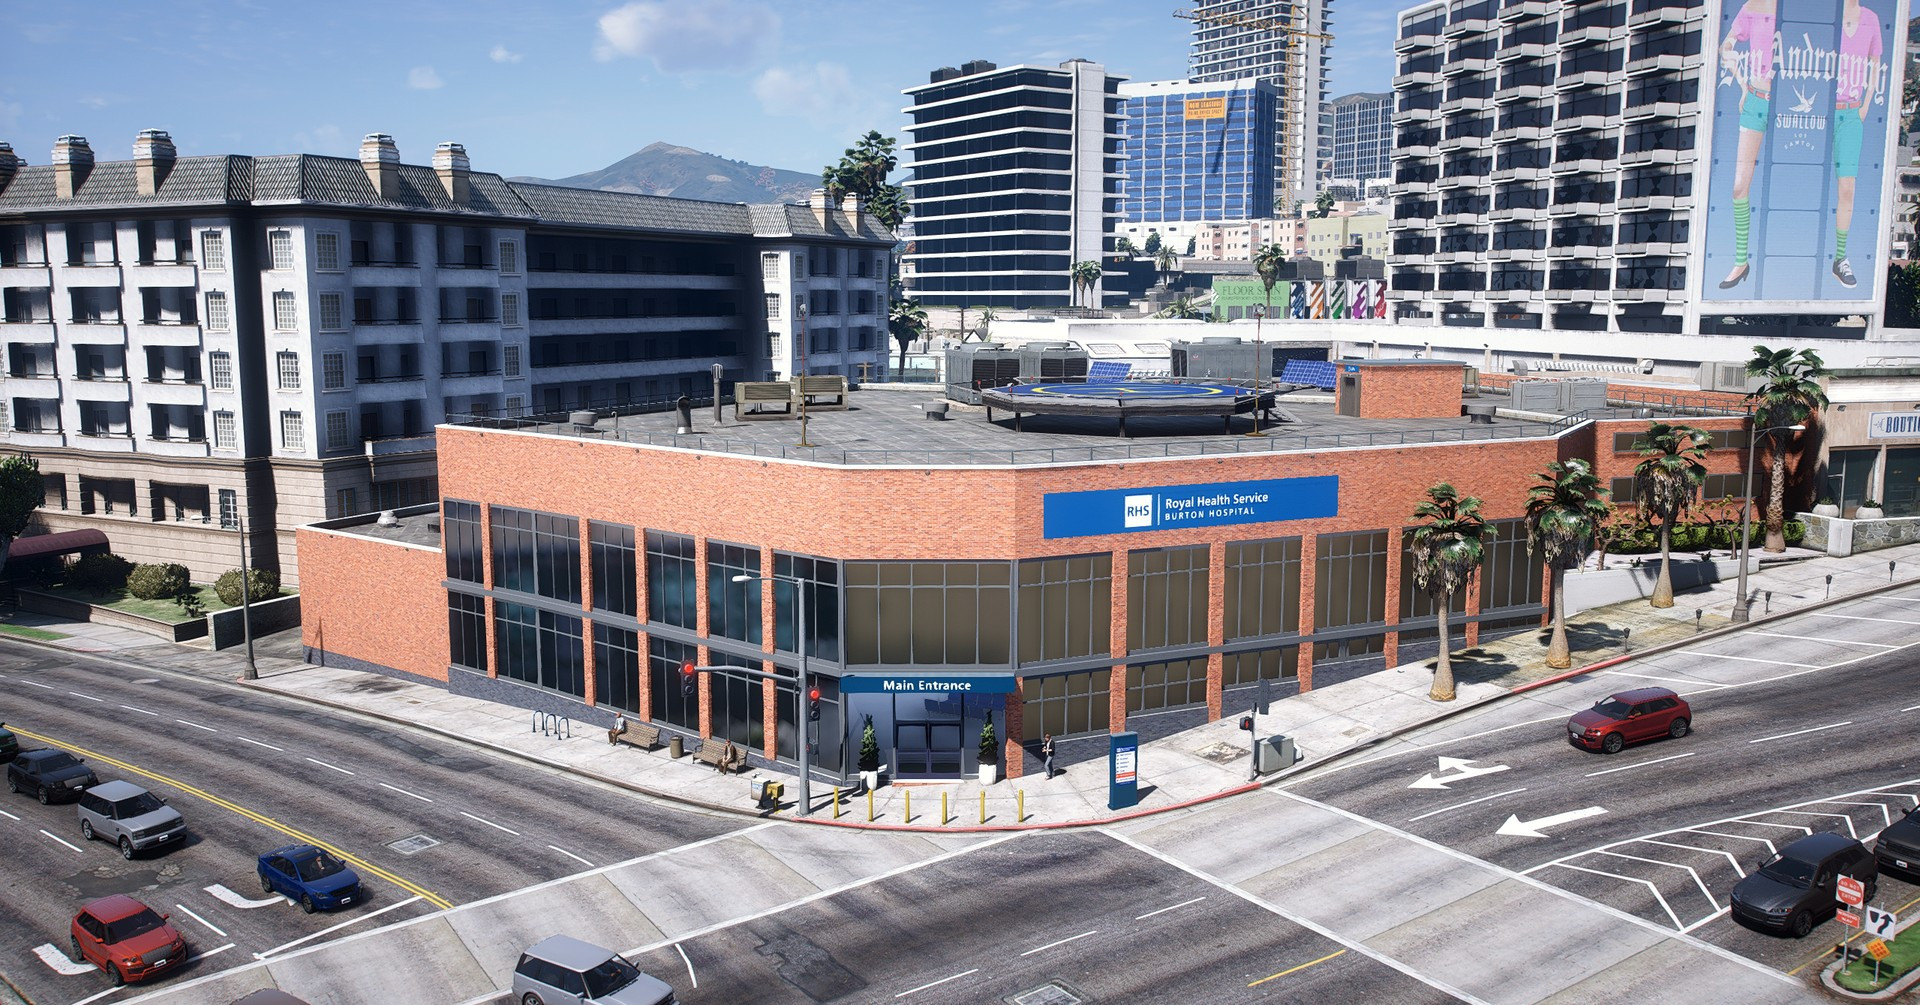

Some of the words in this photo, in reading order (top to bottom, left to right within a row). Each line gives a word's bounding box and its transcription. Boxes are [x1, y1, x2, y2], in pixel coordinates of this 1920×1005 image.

[1718, 46, 1764, 90] San
[1765, 30, 1889, 107] Androgyny
[1775, 113, 1827, 131] SWALLOW
[1783, 139, 1816, 152] SANTOS
[1222, 285, 1254, 296] FLOOR
[1165, 496, 1194, 511] Royal
[1197, 493, 1231, 507] Health
[1233, 491, 1269, 504] Service
[1127, 504, 1150, 517] RHS
[1164, 510, 1204, 521] BURTON
[1209, 507, 1255, 518] HOSPITAL
[883, 679, 914, 690] Main
[918, 680, 972, 691] Entrance
